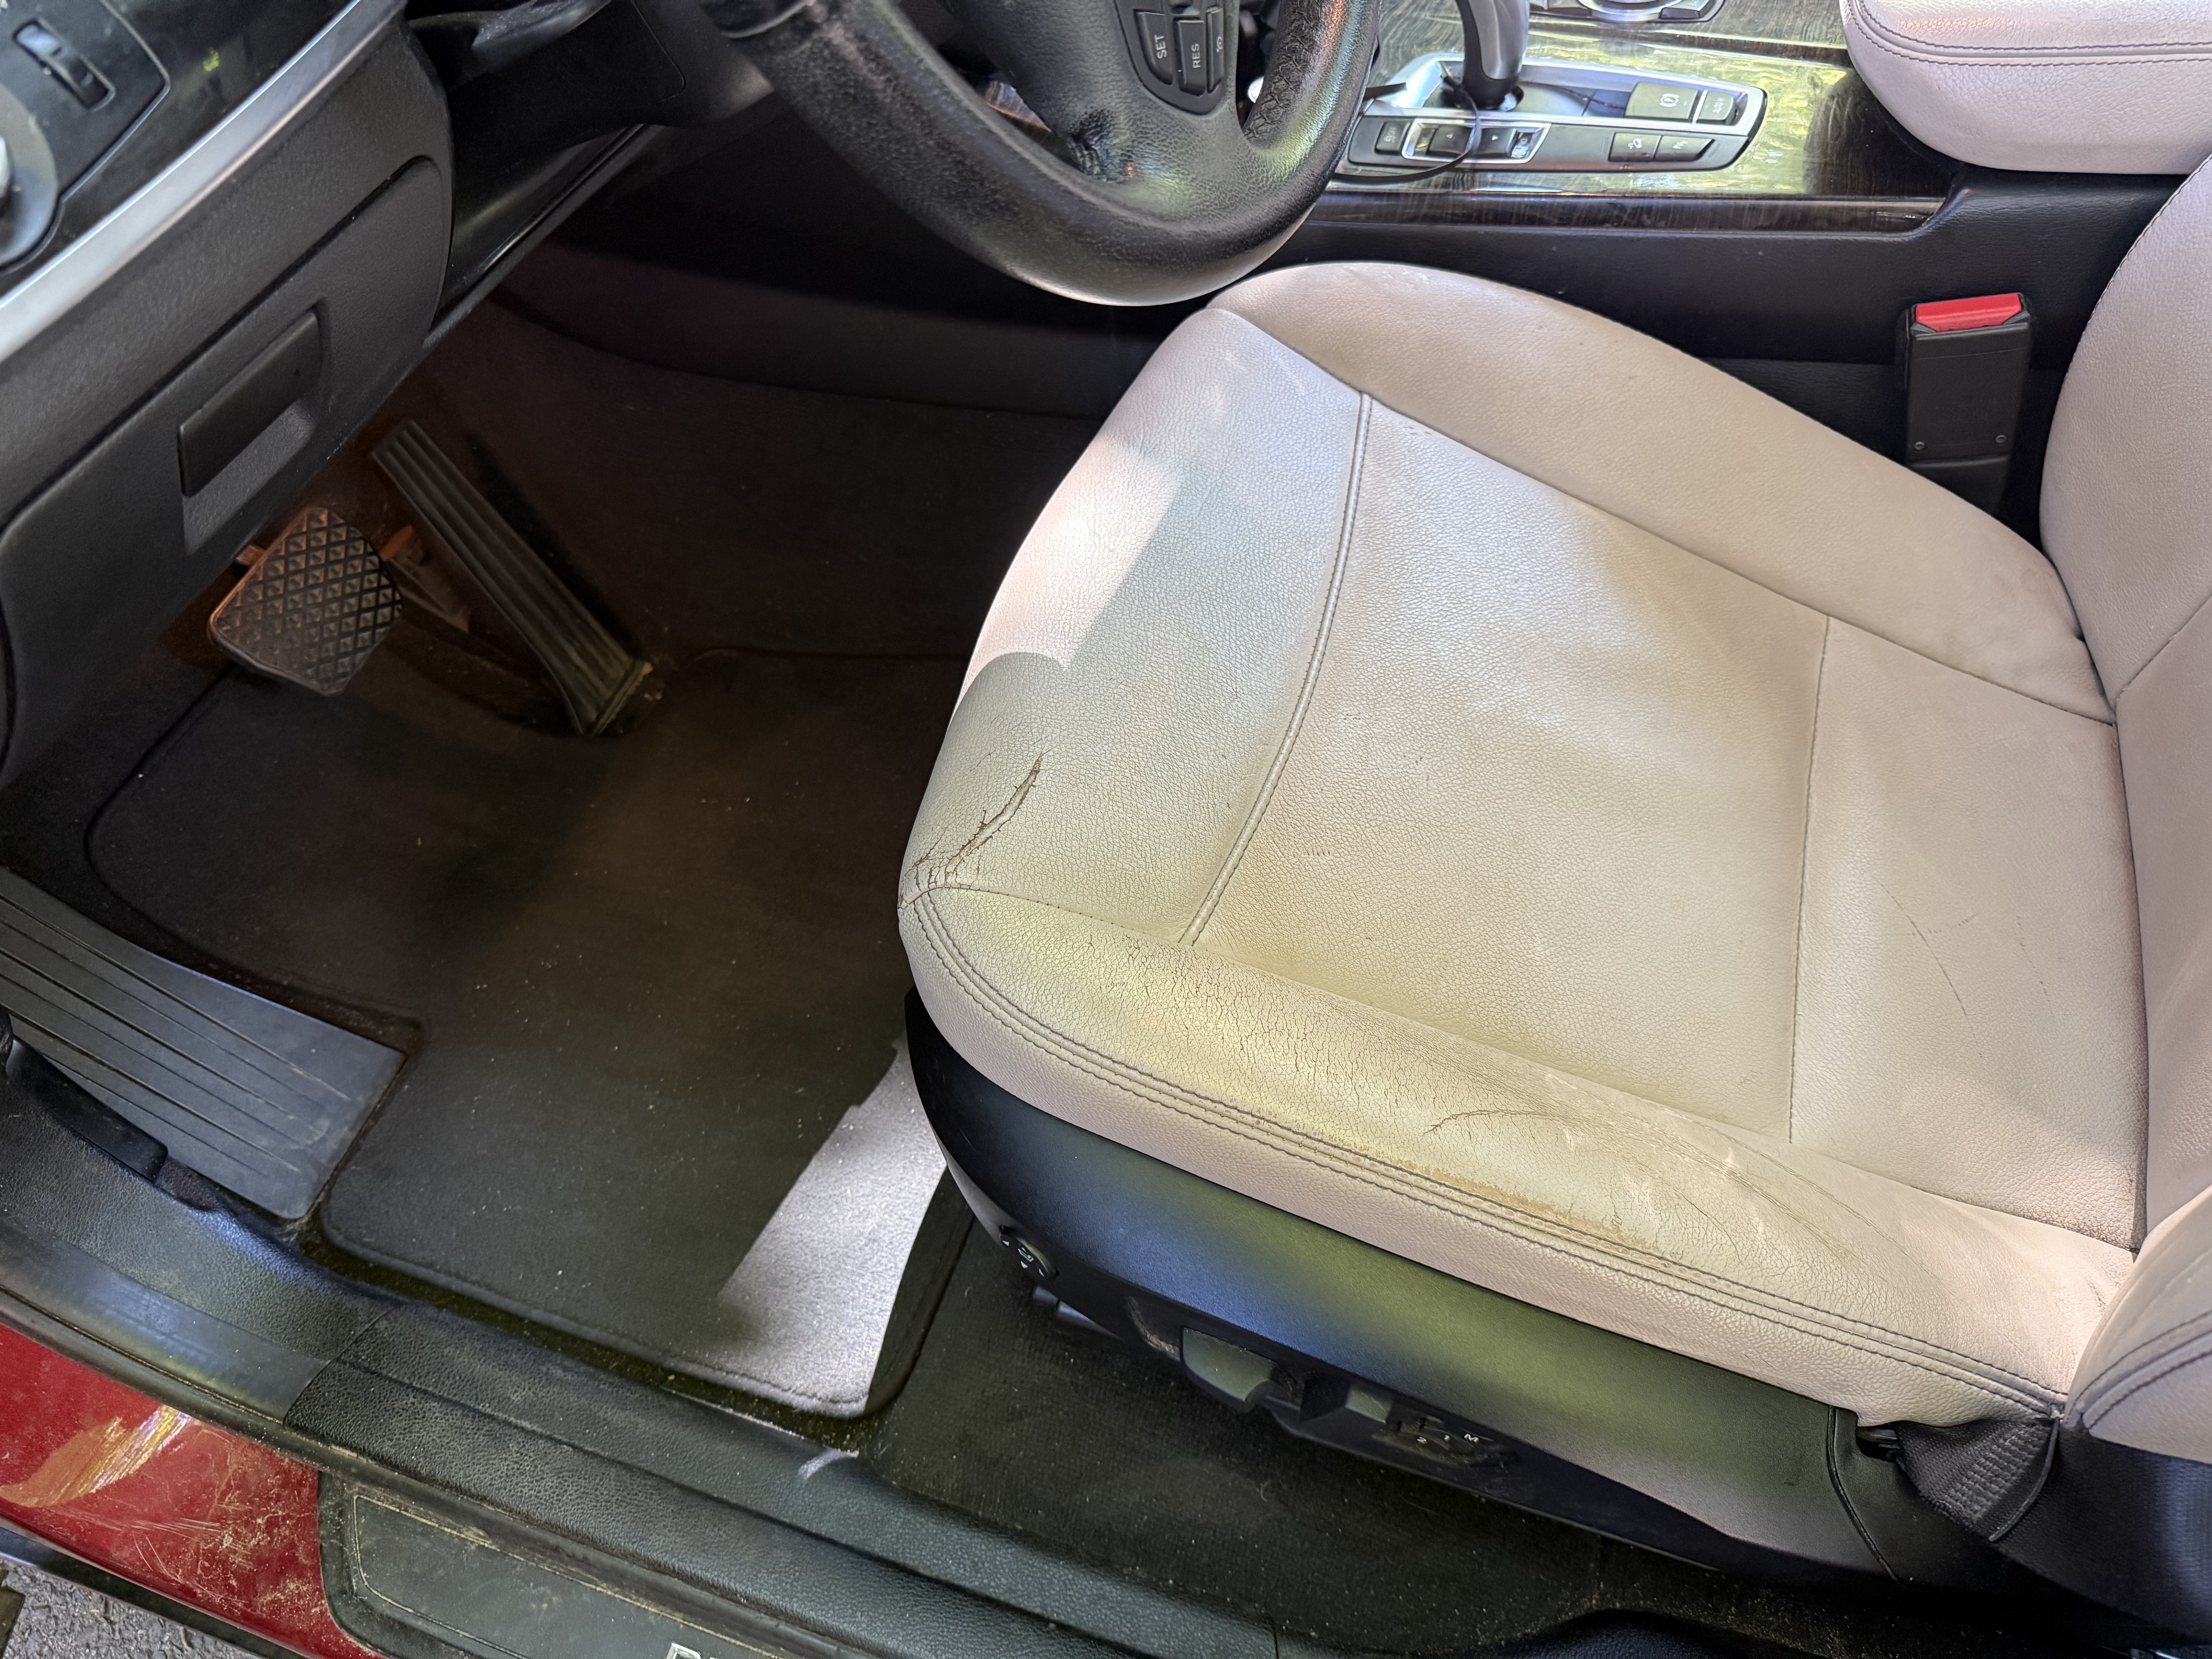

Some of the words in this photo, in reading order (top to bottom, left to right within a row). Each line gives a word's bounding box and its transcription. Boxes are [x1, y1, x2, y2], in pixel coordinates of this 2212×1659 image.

[1154, 35, 1167, 59] SET
[1192, 43, 1200, 68] RES
[1464, 1433, 1479, 1443] M
